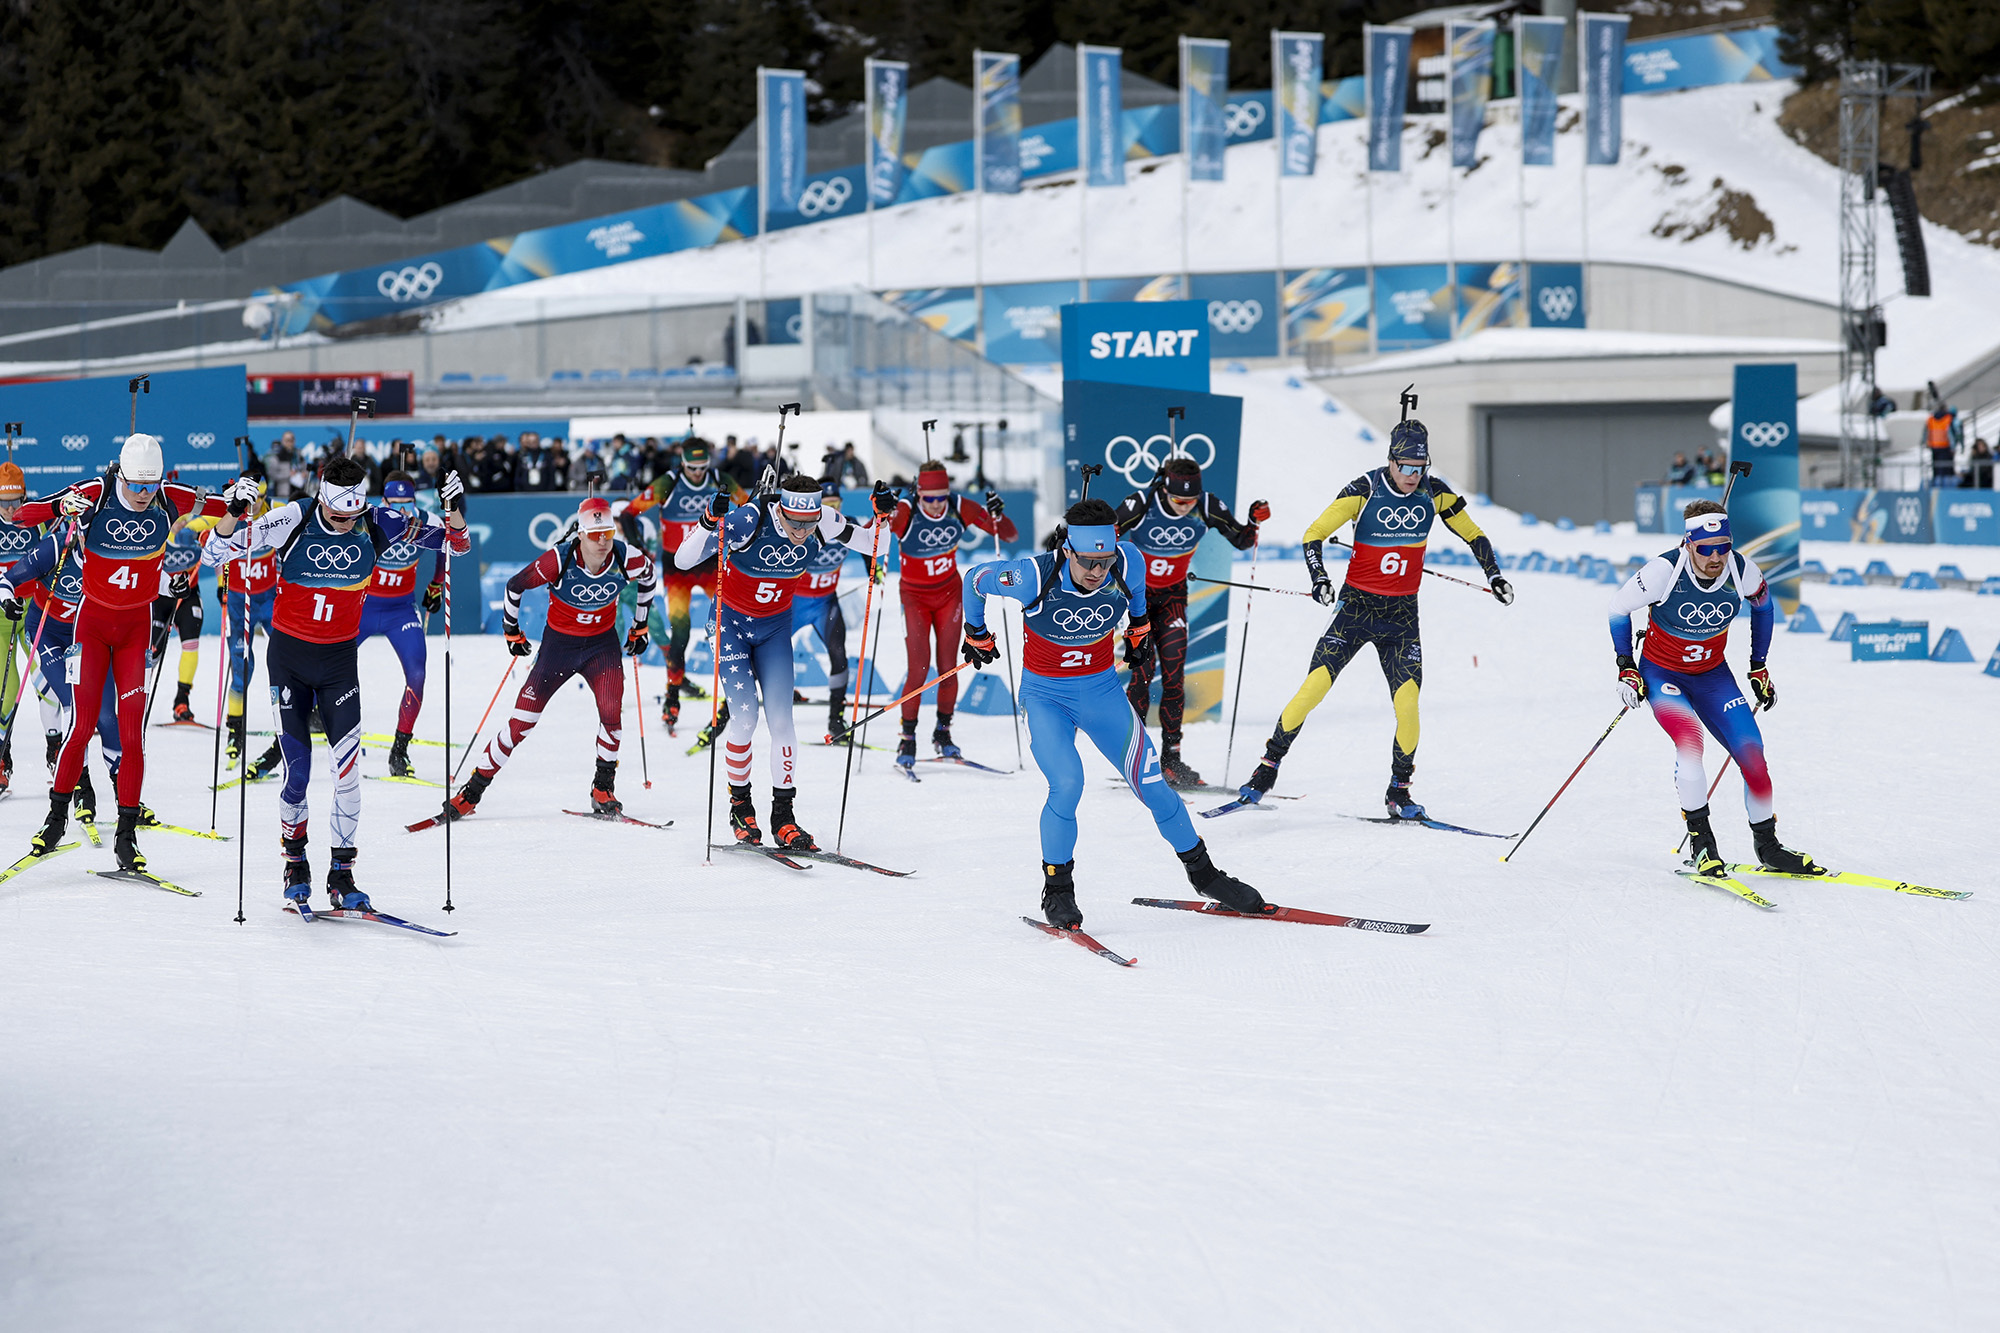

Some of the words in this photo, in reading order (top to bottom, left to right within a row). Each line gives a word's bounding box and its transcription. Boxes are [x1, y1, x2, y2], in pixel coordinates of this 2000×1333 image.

[1090, 329, 1199, 360] START
[335, 378, 359, 390] FRA
[301, 390, 351, 406] FRANCE
[64, 465, 83, 473] GAMES
[174, 463, 198, 471] OLYMPIC
[199, 463, 220, 471] WINTER
[220, 463, 240, 471] GAMES
[788, 496, 816, 510] USA
[260, 519, 285, 531] CRAFT
[100, 541, 122, 550] MILANO
[1306, 549, 1321, 570] SWE
[1380, 552, 1409, 577] 61
[1150, 559, 1175, 576] 91
[108, 566, 139, 590] 41
[301, 571, 324, 579] MILANO
[324, 572, 348, 580] CORTINA
[754, 582, 783, 604] 51
[312, 593, 334, 622] 11
[1046, 633, 1074, 641] MILANO
[1074, 632, 1102, 641] CORTINA
[1697, 626, 1720, 634] CORTINA
[1859, 632, 1921, 645] HAND-OVER
[1682, 644, 1713, 663] 31
[1874, 642, 1906, 653] START
[46, 655, 65, 667] FINLA
[1060, 650, 1092, 668] 21
[121, 688, 140, 700] CRAFT
[335, 687, 357, 706] CRAFT
[782, 746, 793, 785] USA
[1909, 885, 1963, 899] FISCHER
[1361, 921, 1411, 936] ROSSIGNOL
